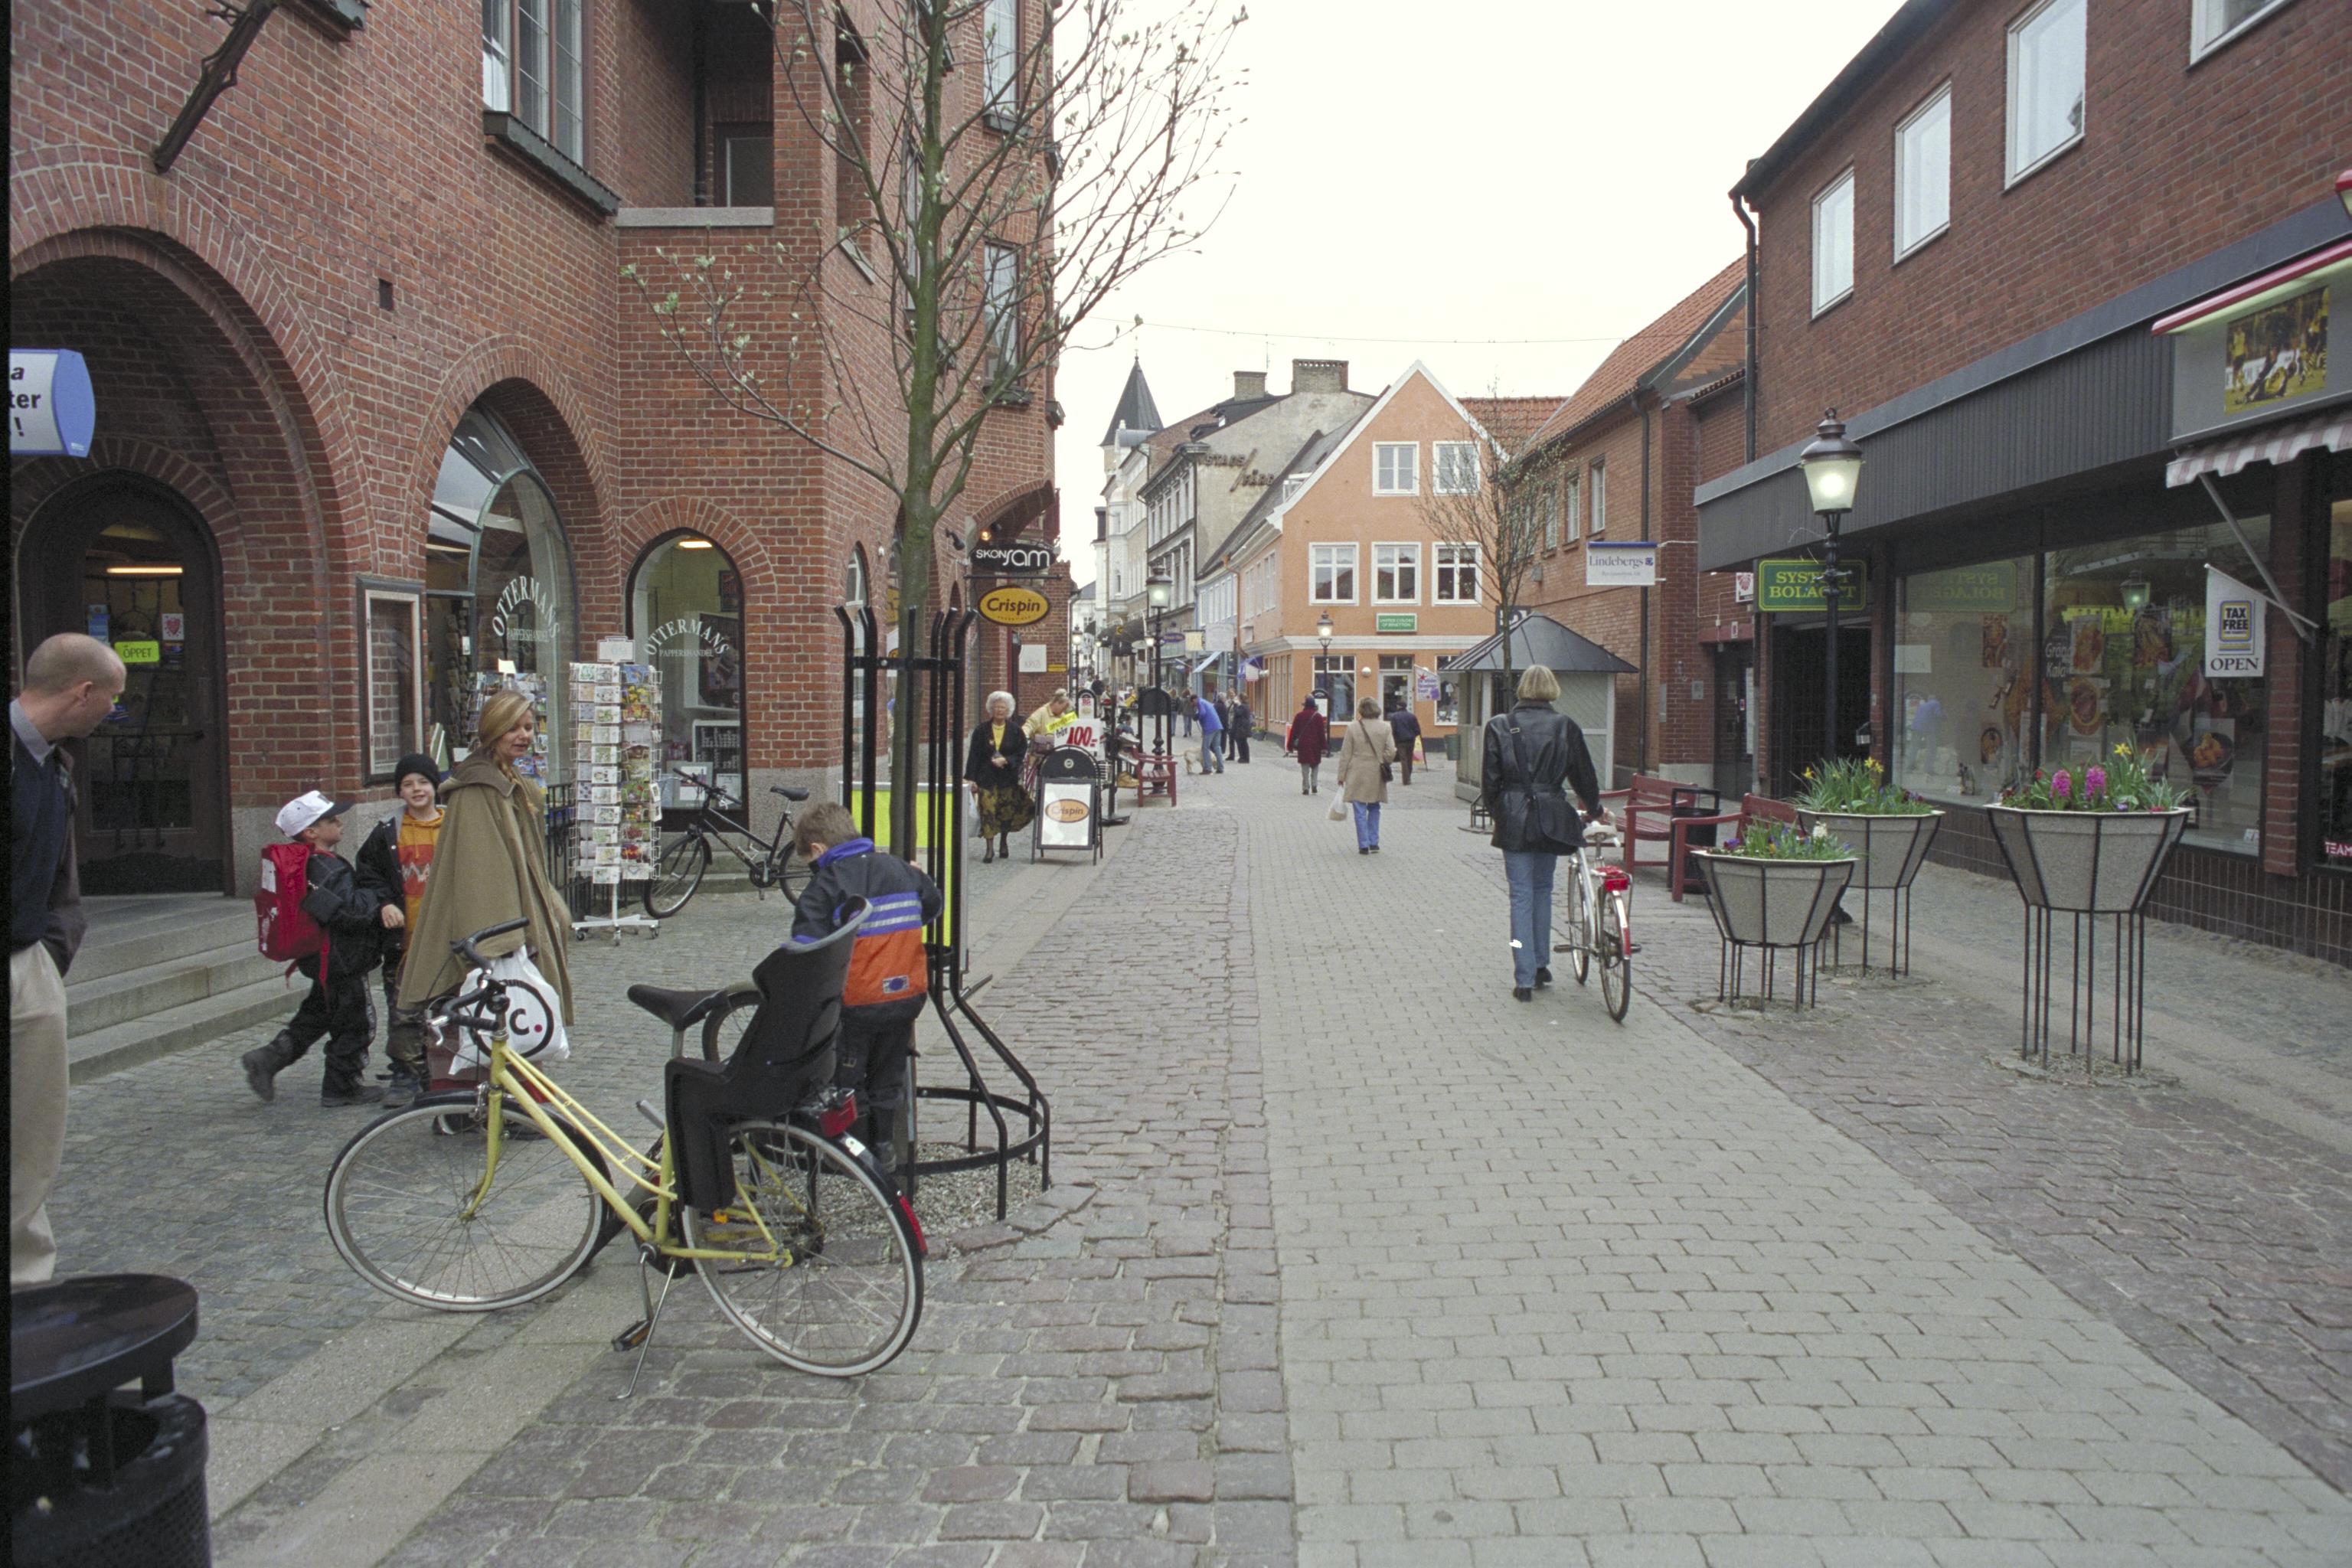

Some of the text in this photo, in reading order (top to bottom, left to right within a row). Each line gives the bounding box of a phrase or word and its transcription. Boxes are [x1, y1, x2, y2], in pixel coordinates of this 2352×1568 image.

[1589, 556, 1644, 569] Lindebergs
[492, 576, 560, 637] OTTERMANS
[987, 597, 1040, 616] Crispin
[2226, 607, 2246, 619] TAX
[2223, 619, 2248, 630] FREE
[643, 619, 730, 655] OTTERMANS
[123, 645, 152, 658] ÖPPET
[659, 648, 714, 658] PAPPERSHANDEL
[2210, 657, 2259, 671] OPEN
[1051, 805, 1084, 818] Crispin
